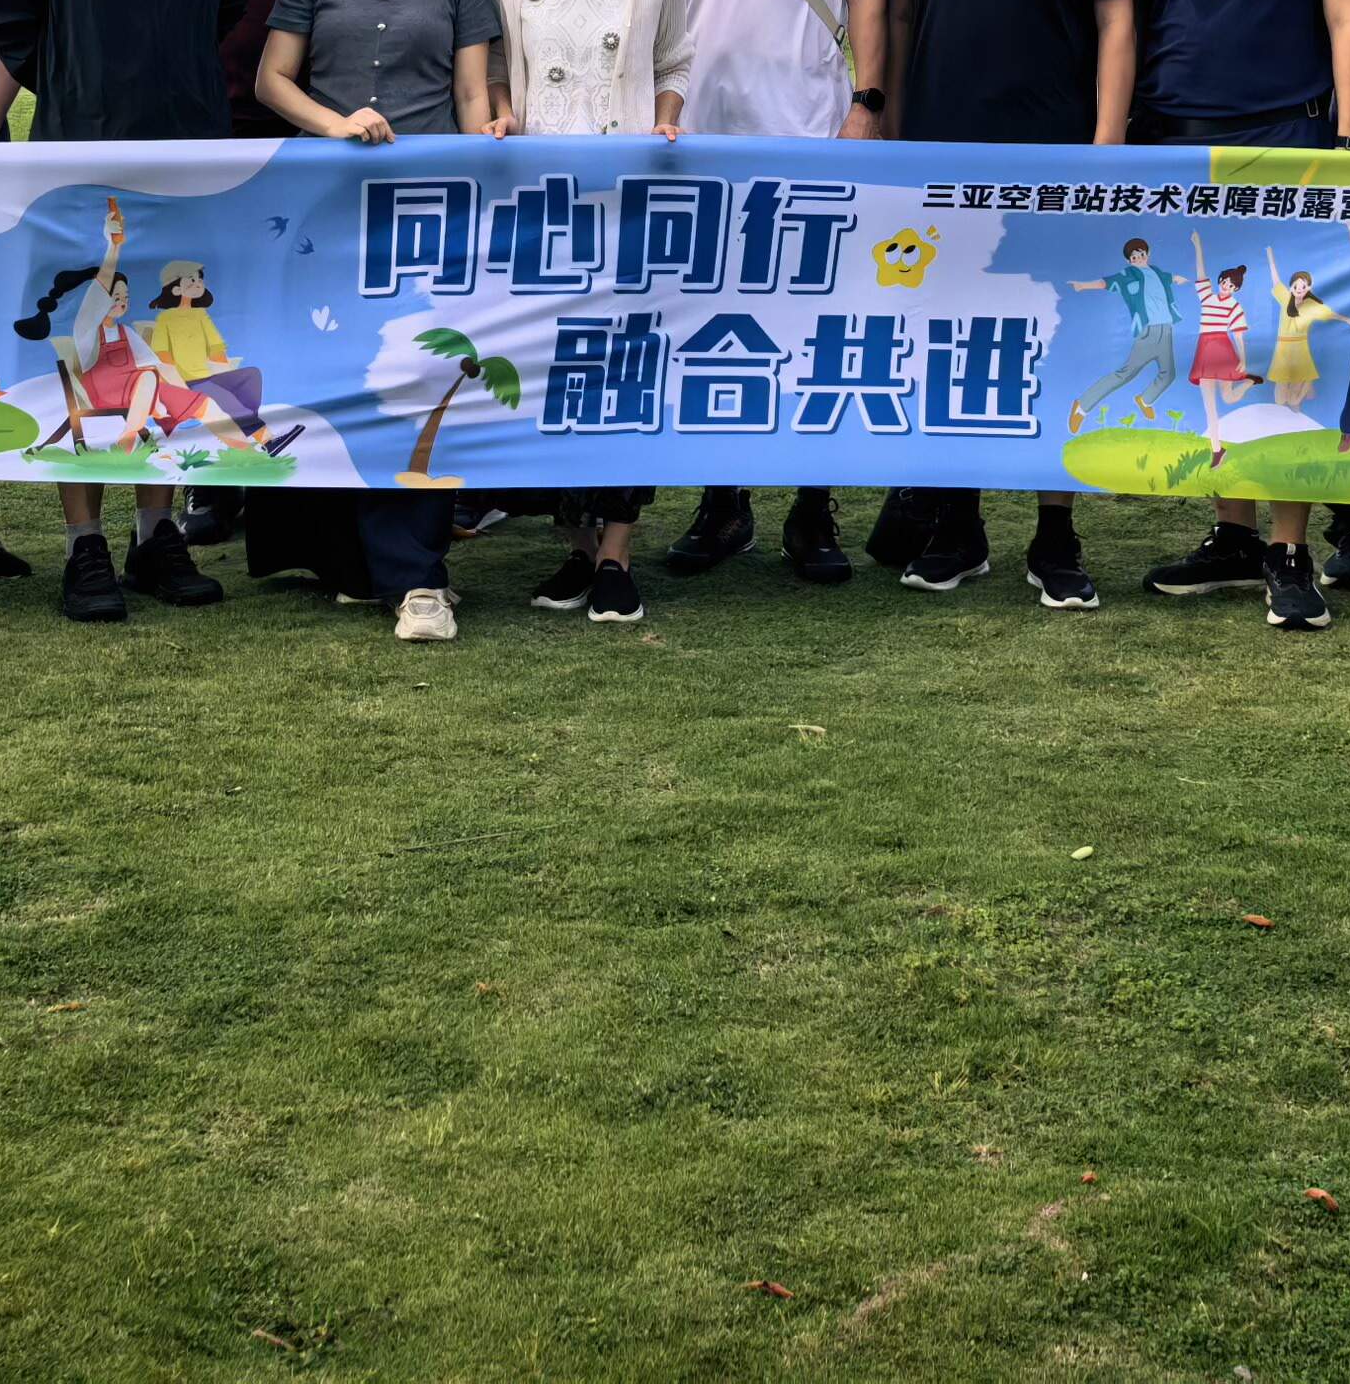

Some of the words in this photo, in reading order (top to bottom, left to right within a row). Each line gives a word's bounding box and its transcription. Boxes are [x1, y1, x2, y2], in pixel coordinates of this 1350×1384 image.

[359, 174, 856, 296] 同心同行
[537, 312, 1042, 436] 融合共进
